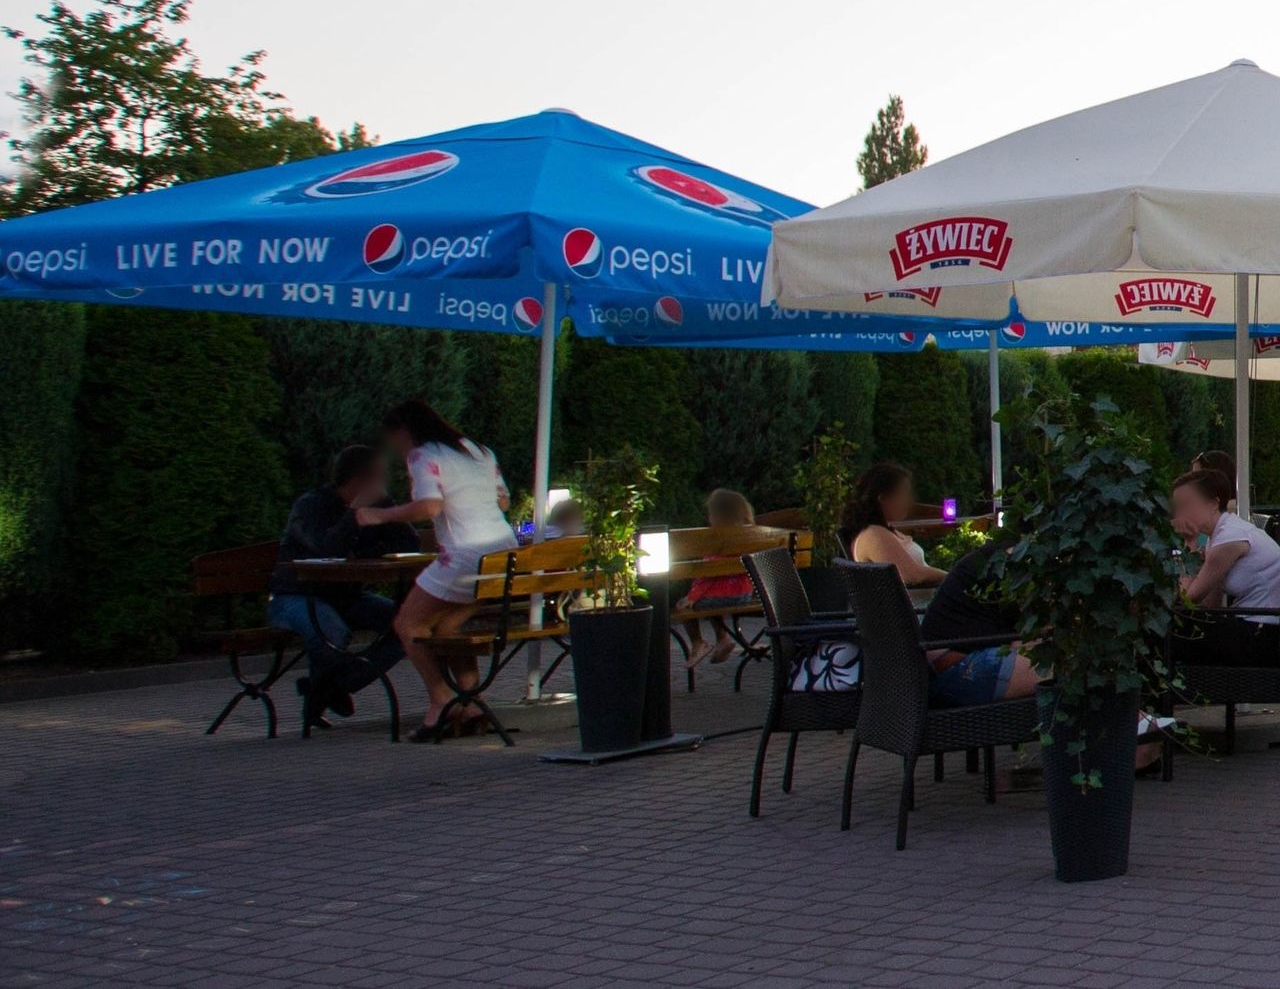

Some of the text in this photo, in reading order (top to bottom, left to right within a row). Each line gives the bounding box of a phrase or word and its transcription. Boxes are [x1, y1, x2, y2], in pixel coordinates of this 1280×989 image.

[6, 237, 331, 280] pepsi LIVE FOR NOW
[406, 229, 494, 266] pepsi
[905, 222, 1000, 261] ŻYWIEC
[610, 246, 764, 284] pepsi LIV
